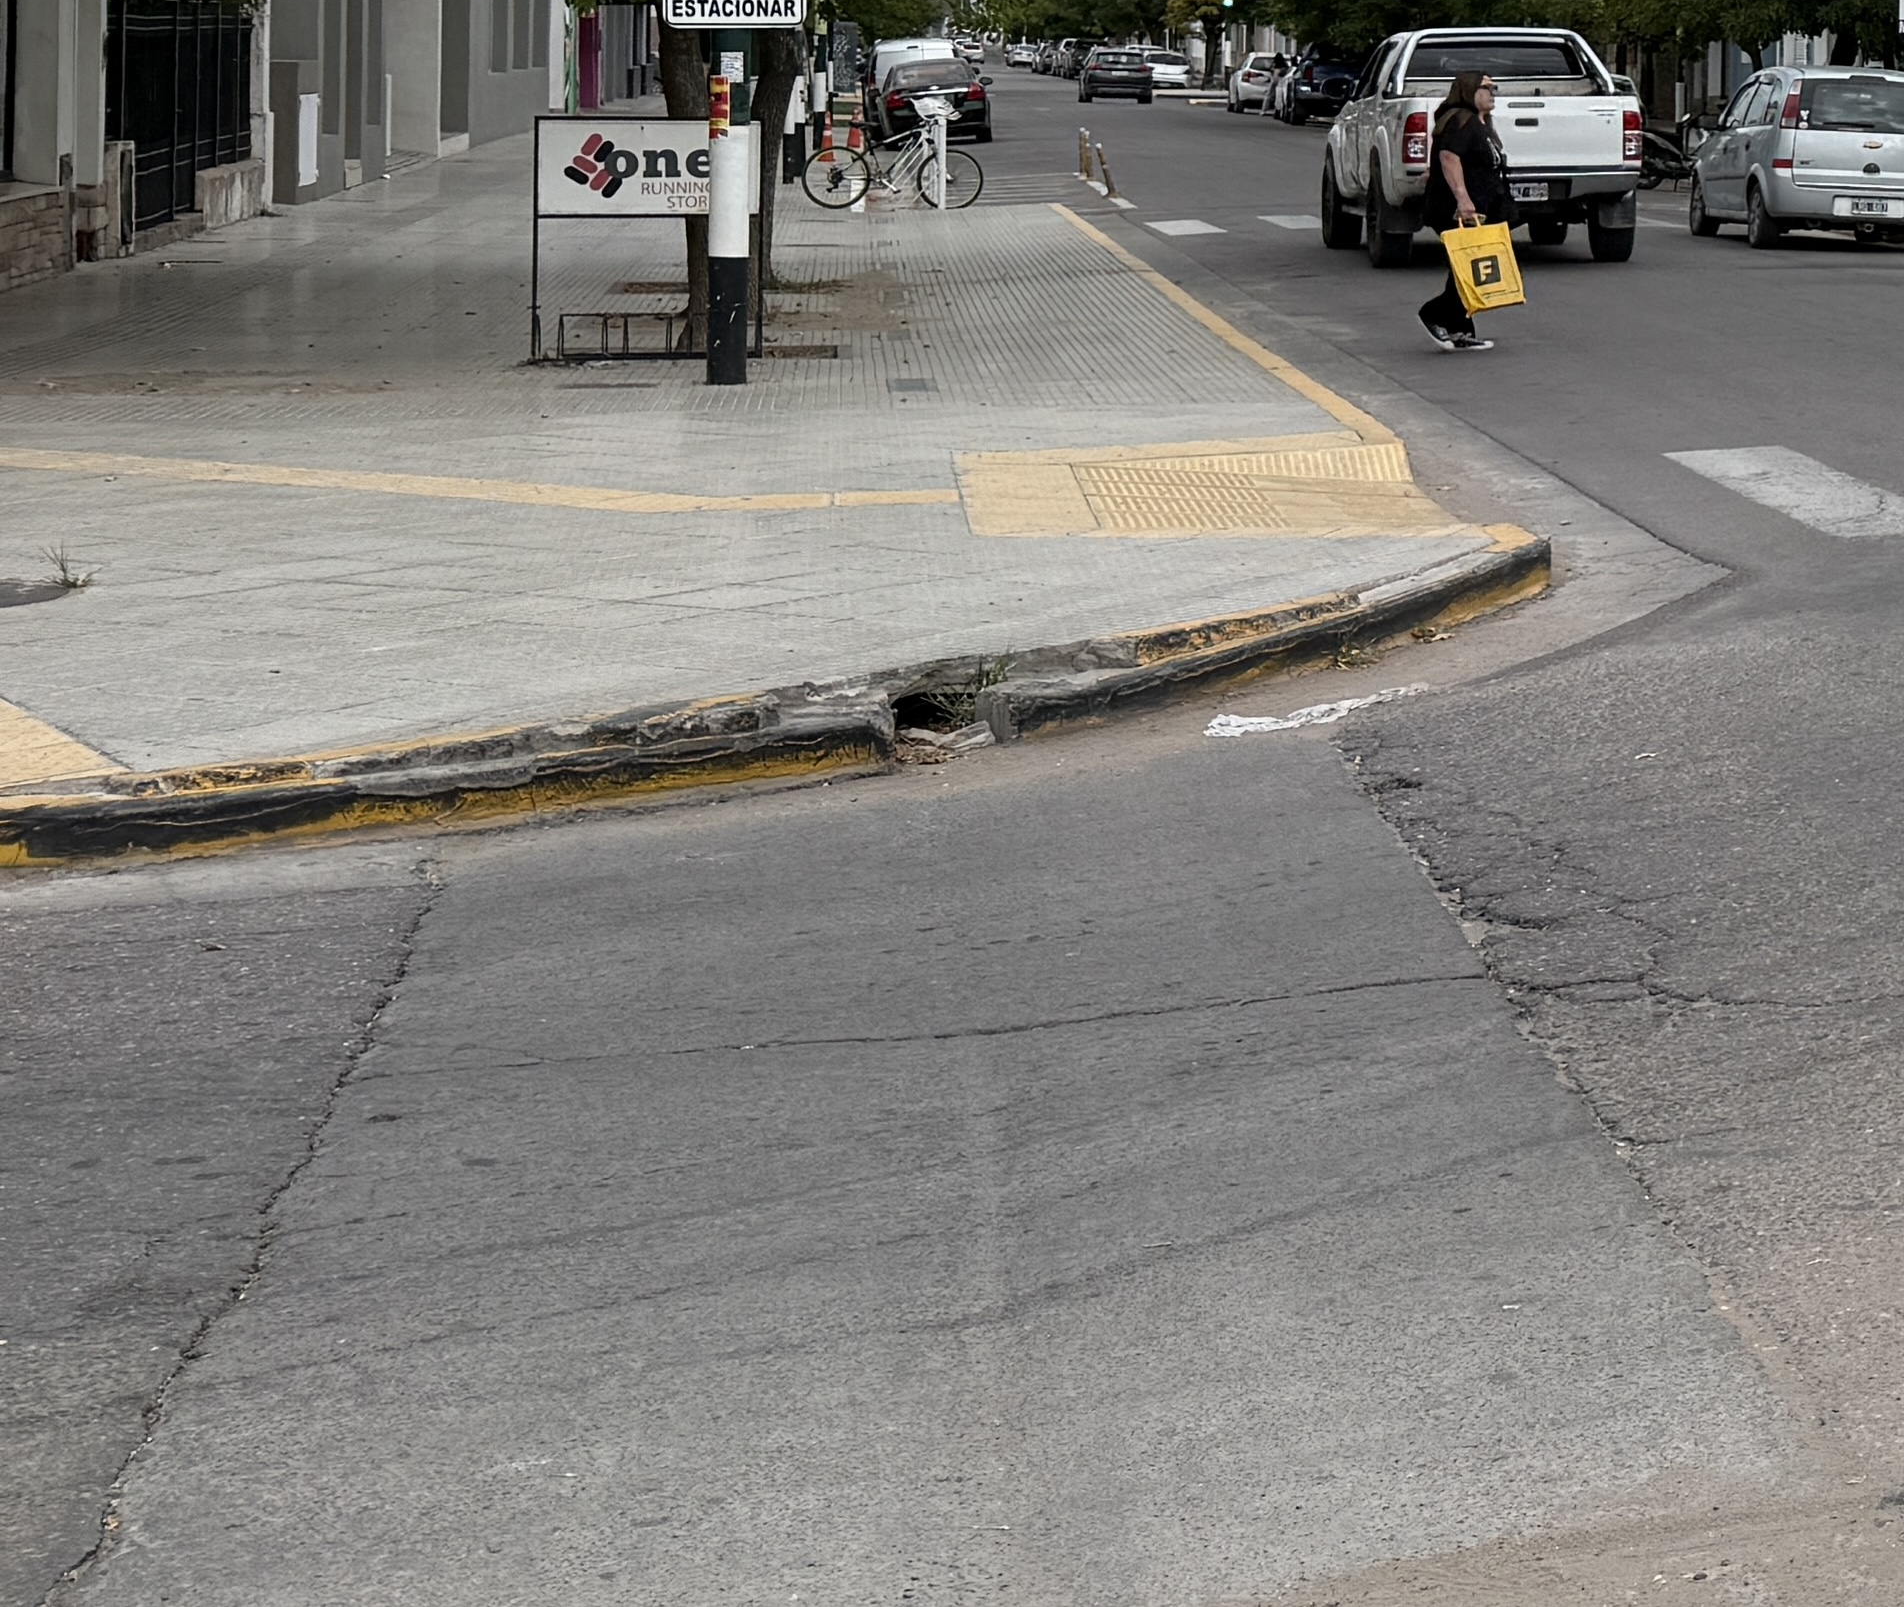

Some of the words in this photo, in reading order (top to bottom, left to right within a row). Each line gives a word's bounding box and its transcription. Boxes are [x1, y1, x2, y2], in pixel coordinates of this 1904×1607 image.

[672, 0, 796, 18] ESTACIONAR
[604, 148, 710, 178] one
[667, 195, 708, 209] STOR
[1478, 261, 1493, 282] F
